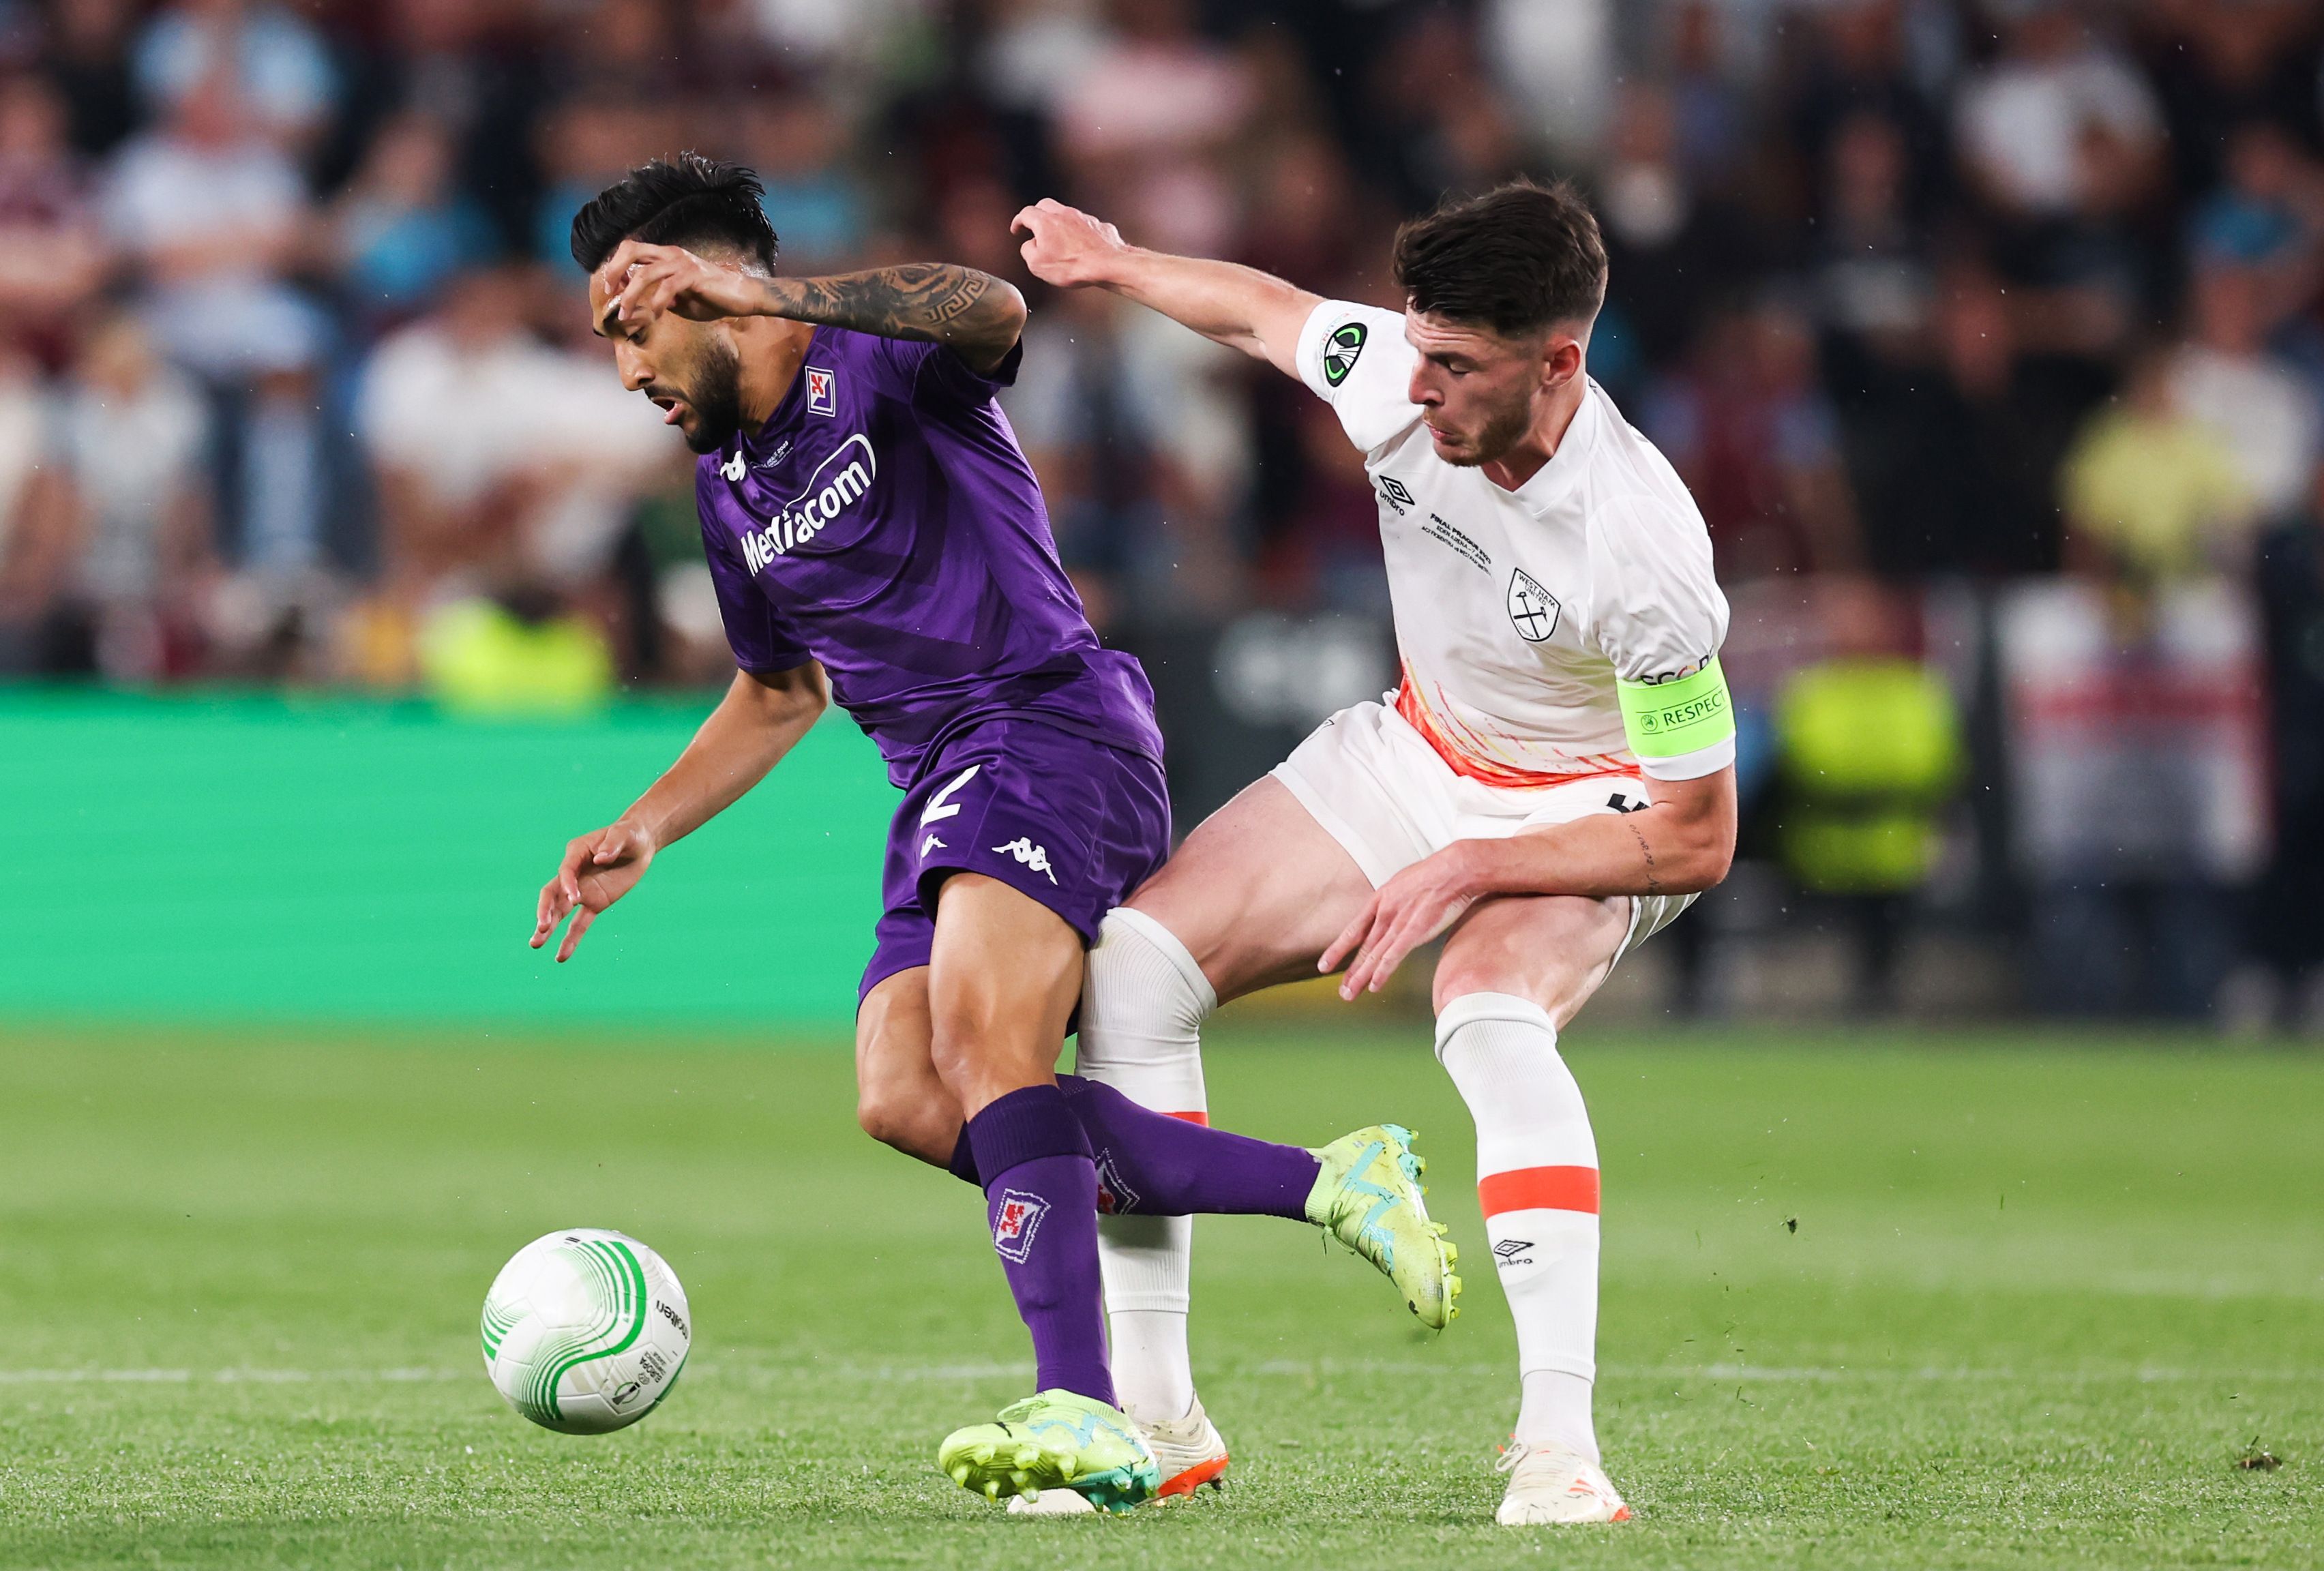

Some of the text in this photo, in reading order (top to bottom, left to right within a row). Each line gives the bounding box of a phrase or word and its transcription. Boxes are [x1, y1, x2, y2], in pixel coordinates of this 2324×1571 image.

[741, 461, 872, 578] Mediacom
[1380, 490, 1405, 516] umbro
[1430, 513, 1450, 530] FINAL
[1452, 527, 1479, 550] PRAGUE
[1519, 573, 1555, 609] WEST HAM
[1525, 585, 1547, 605] UNITED
[1517, 623, 1534, 638] LONDON
[1663, 689, 1726, 726] RESPECT
